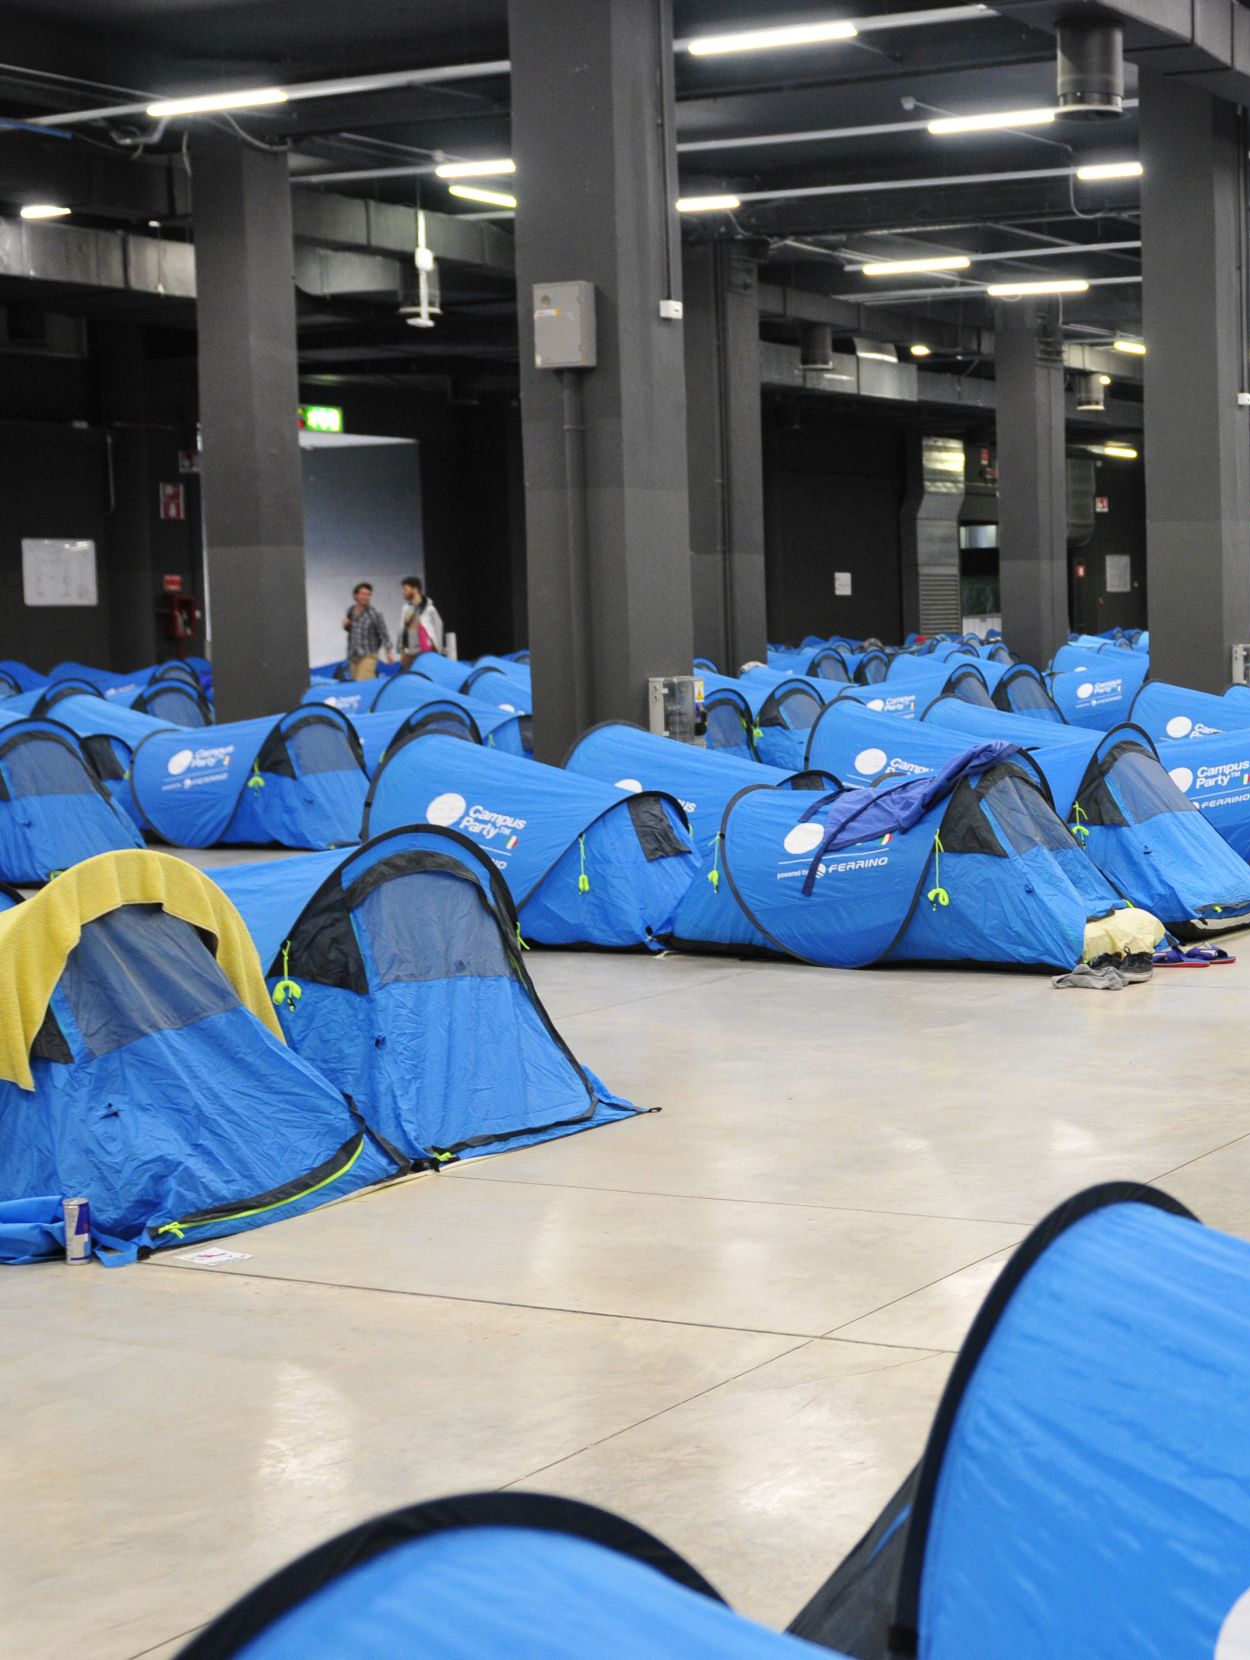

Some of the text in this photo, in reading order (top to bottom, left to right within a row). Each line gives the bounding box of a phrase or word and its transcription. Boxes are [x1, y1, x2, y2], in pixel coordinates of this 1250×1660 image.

[1197, 760, 1250, 778] Campus
[1201, 793, 1250, 809] FERRINO
[469, 805, 527, 830] Campus
[828, 856, 889, 874] FERRINO
